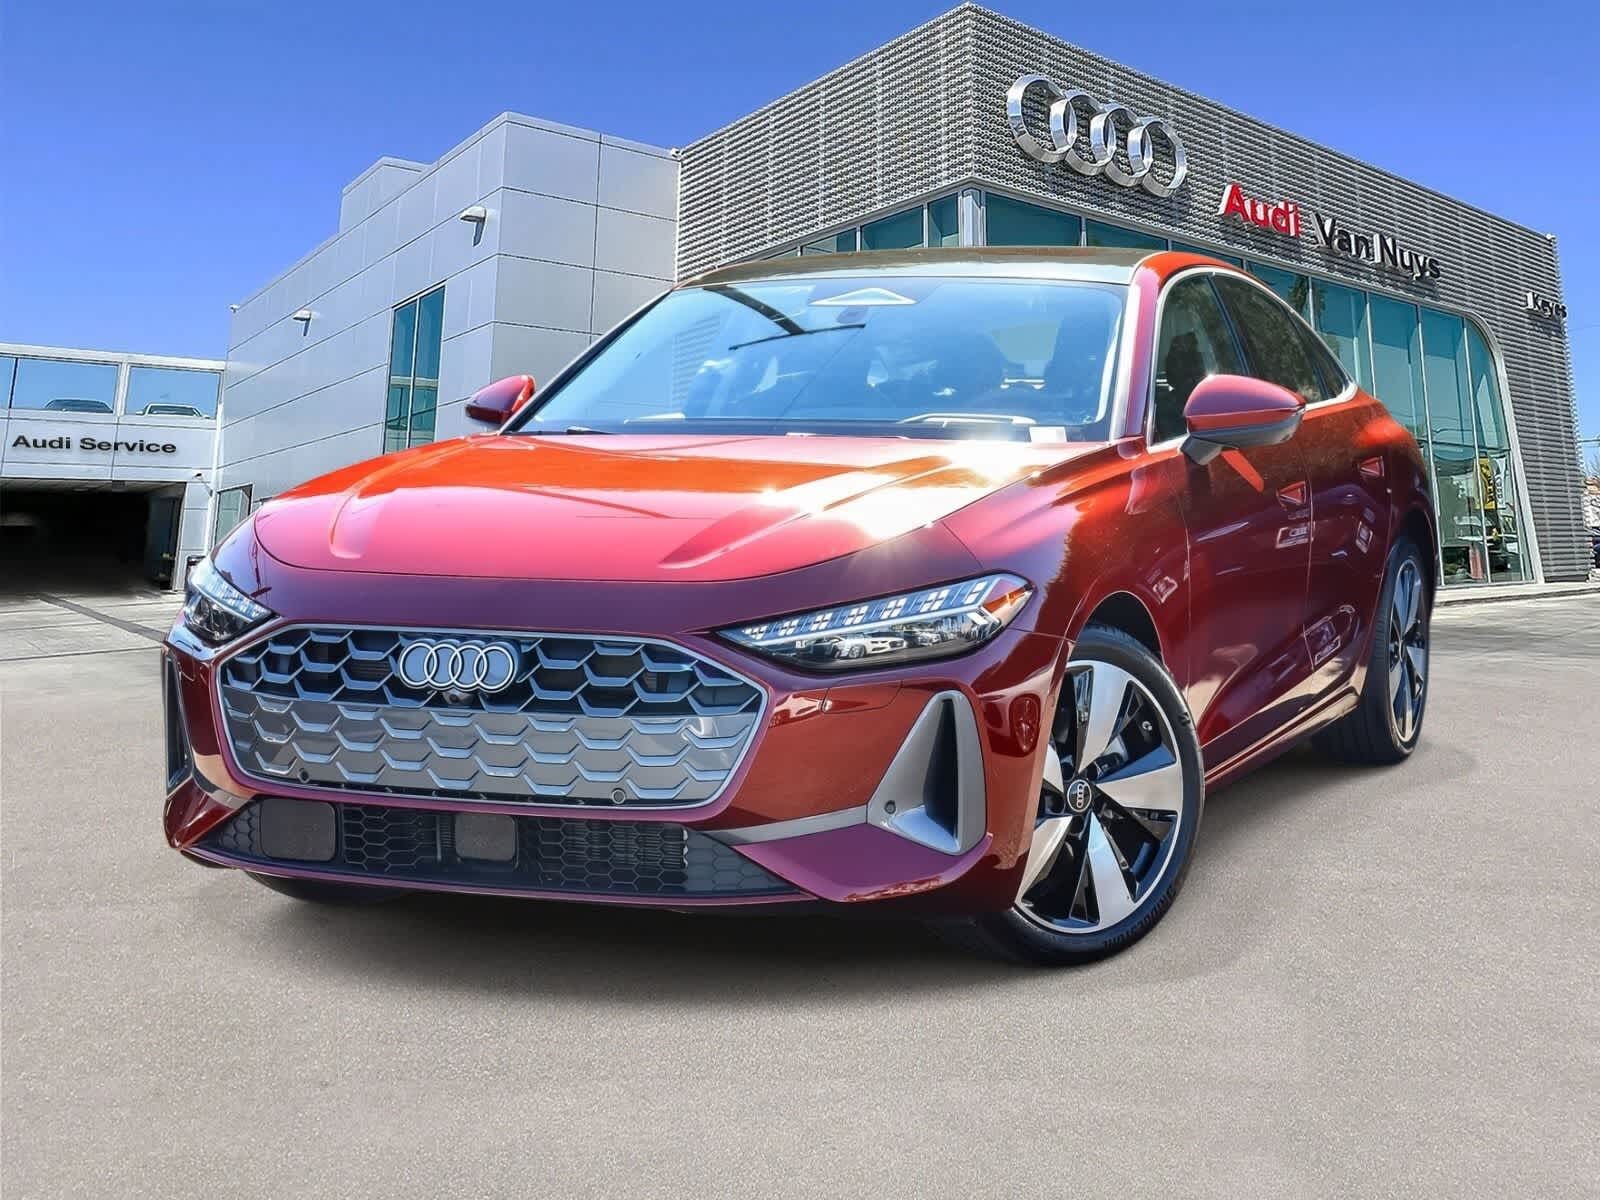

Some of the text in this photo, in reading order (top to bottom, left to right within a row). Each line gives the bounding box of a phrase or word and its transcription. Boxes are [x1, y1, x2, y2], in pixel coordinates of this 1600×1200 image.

[1218, 183, 1441, 280] Audi Van Nuys
[12, 435, 177, 454] Audi Service
